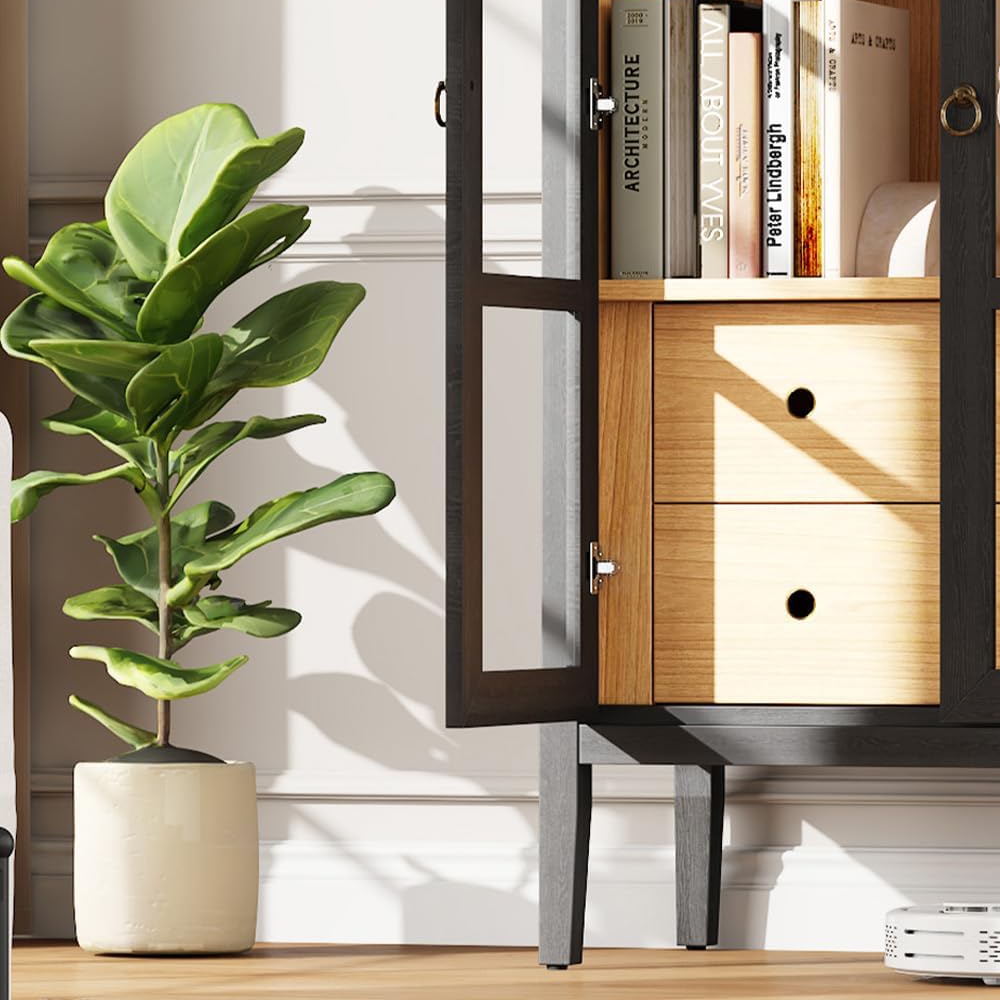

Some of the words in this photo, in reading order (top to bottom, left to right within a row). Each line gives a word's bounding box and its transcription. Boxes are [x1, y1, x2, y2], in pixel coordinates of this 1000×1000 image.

[701, 18, 724, 64] ALL
[624, 54, 640, 192] ARCHITECTURE
[701, 80, 724, 166] ABOUT
[766, 123, 786, 201] Lindbergh
[701, 178, 724, 242] YVES
[766, 209, 782, 247] Peter
